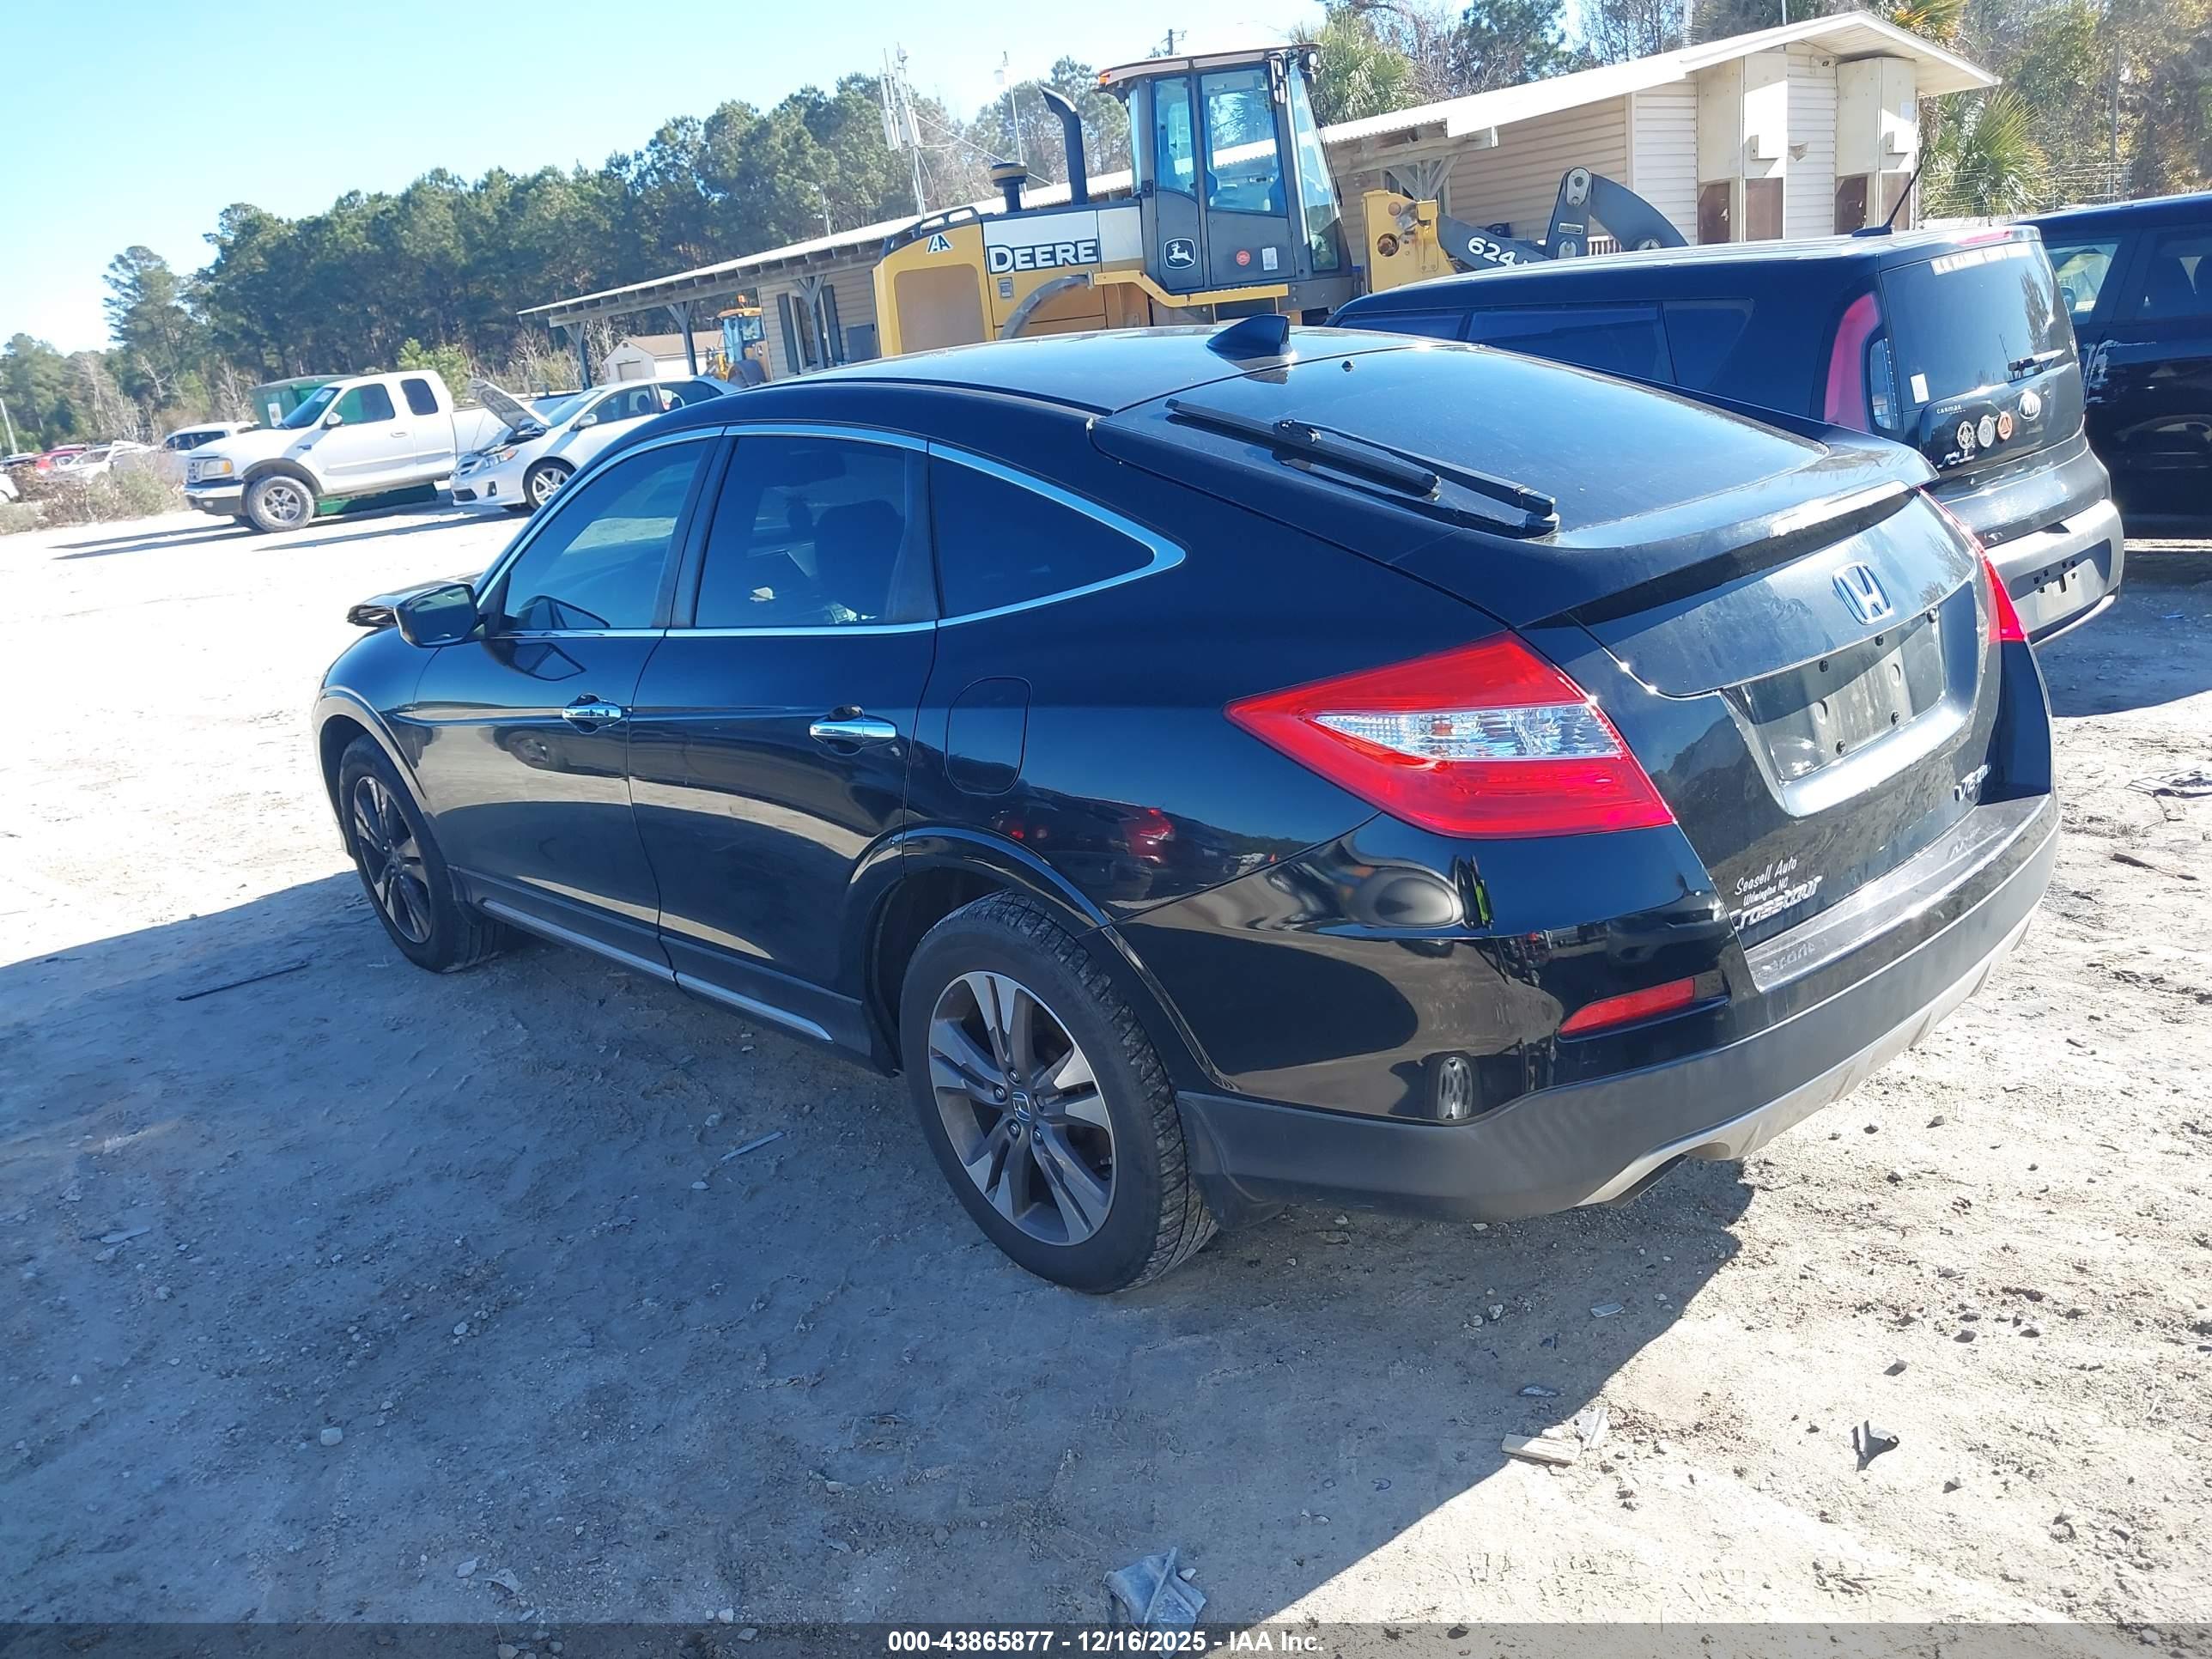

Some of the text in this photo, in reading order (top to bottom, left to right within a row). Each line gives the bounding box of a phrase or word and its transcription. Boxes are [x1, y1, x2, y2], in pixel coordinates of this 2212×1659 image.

[988, 240, 1097, 273] DEERE
[1468, 237, 1528, 268] 624
[1735, 856, 1797, 895] Seasell Auto
[1778, 876, 1789, 891] NC
